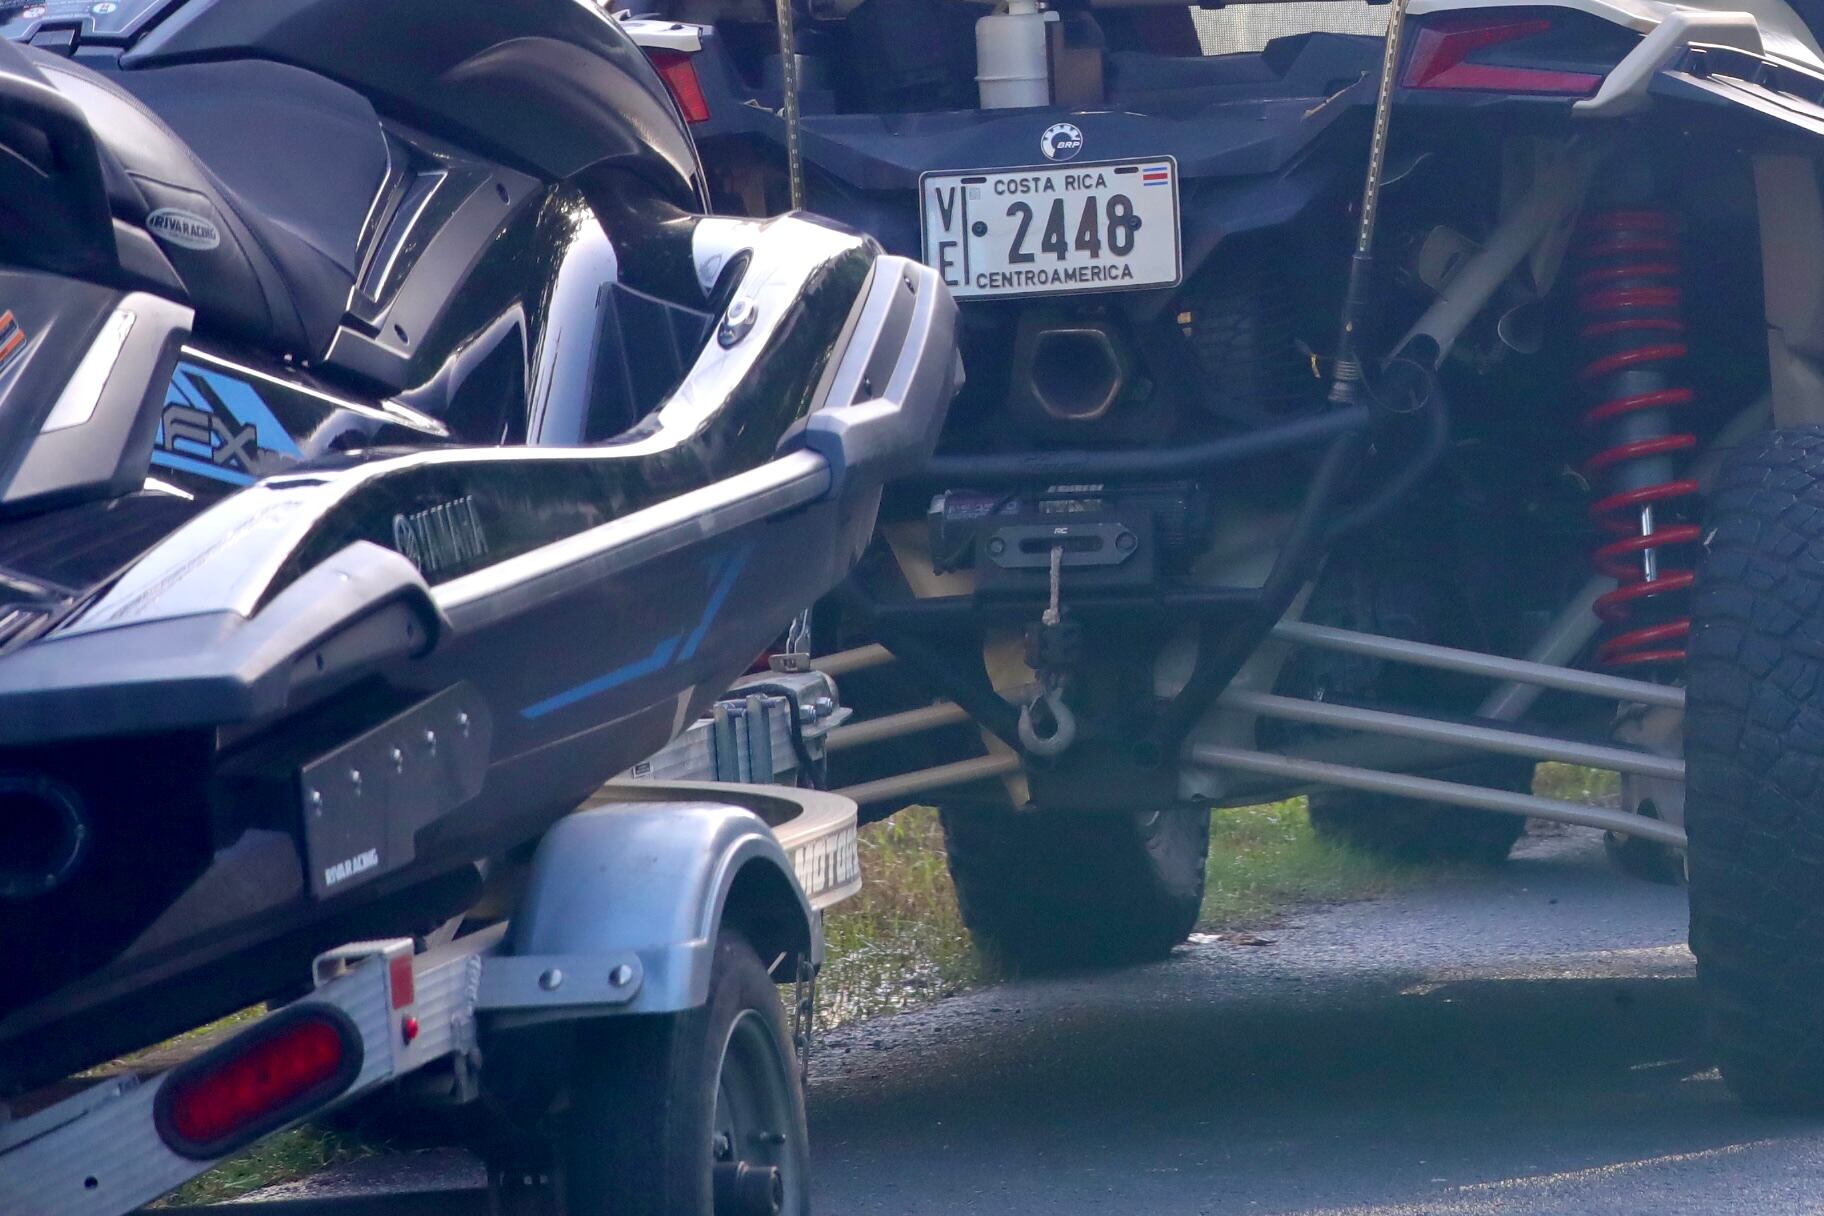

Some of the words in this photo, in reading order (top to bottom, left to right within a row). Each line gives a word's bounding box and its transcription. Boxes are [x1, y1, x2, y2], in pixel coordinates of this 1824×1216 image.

[1056, 141, 1080, 149] BRP
[994, 176, 1055, 195] COSTA
[1065, 173, 1107, 190] RICA
[1006, 194, 1135, 264] 2448
[976, 264, 1133, 289] CENTROAMERICA
